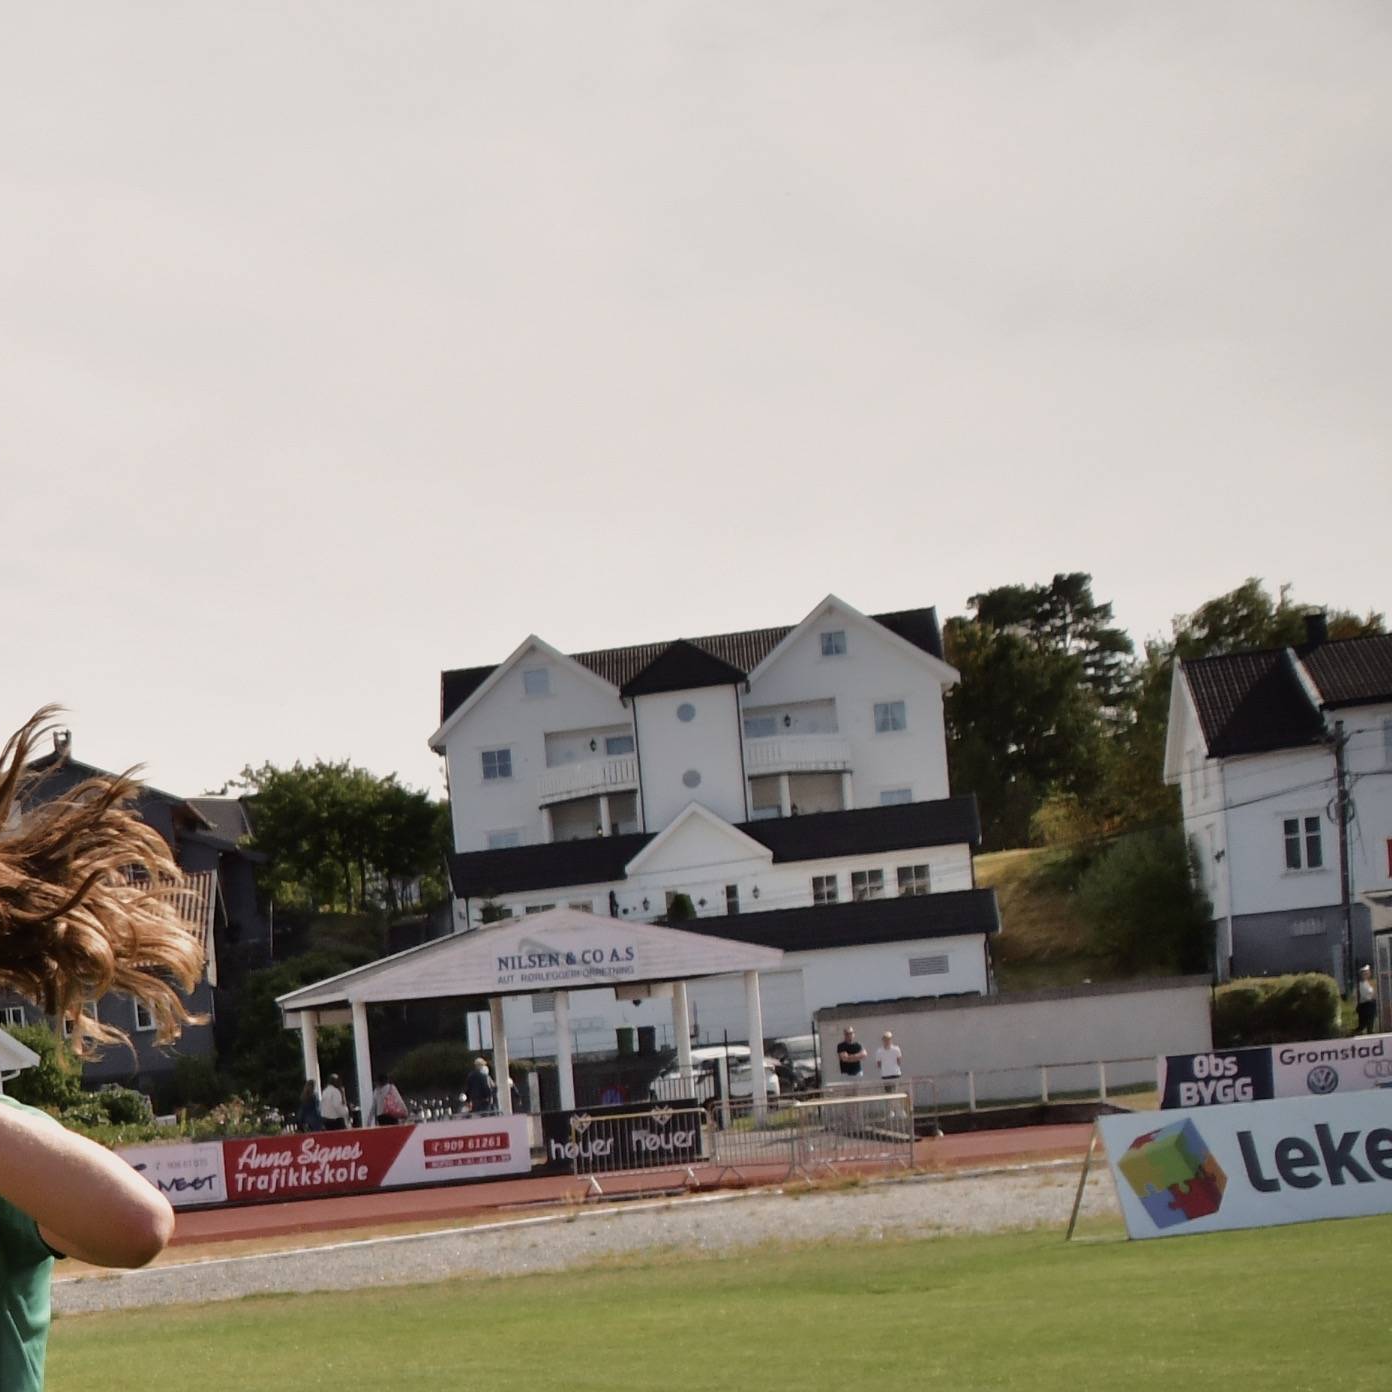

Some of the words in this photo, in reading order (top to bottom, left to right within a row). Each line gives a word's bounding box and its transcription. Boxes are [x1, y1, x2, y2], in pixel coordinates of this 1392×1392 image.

[497, 952, 560, 971] NILSEN
[566, 951, 577, 966] &
[581, 949, 604, 964] CO
[1279, 1039, 1385, 1066] Gromstad
[1179, 1077, 1254, 1107] BYGG
[238, 1143, 293, 1170] Anna
[299, 1138, 363, 1170] Signes
[235, 1165, 369, 1194] Trafikkskole
